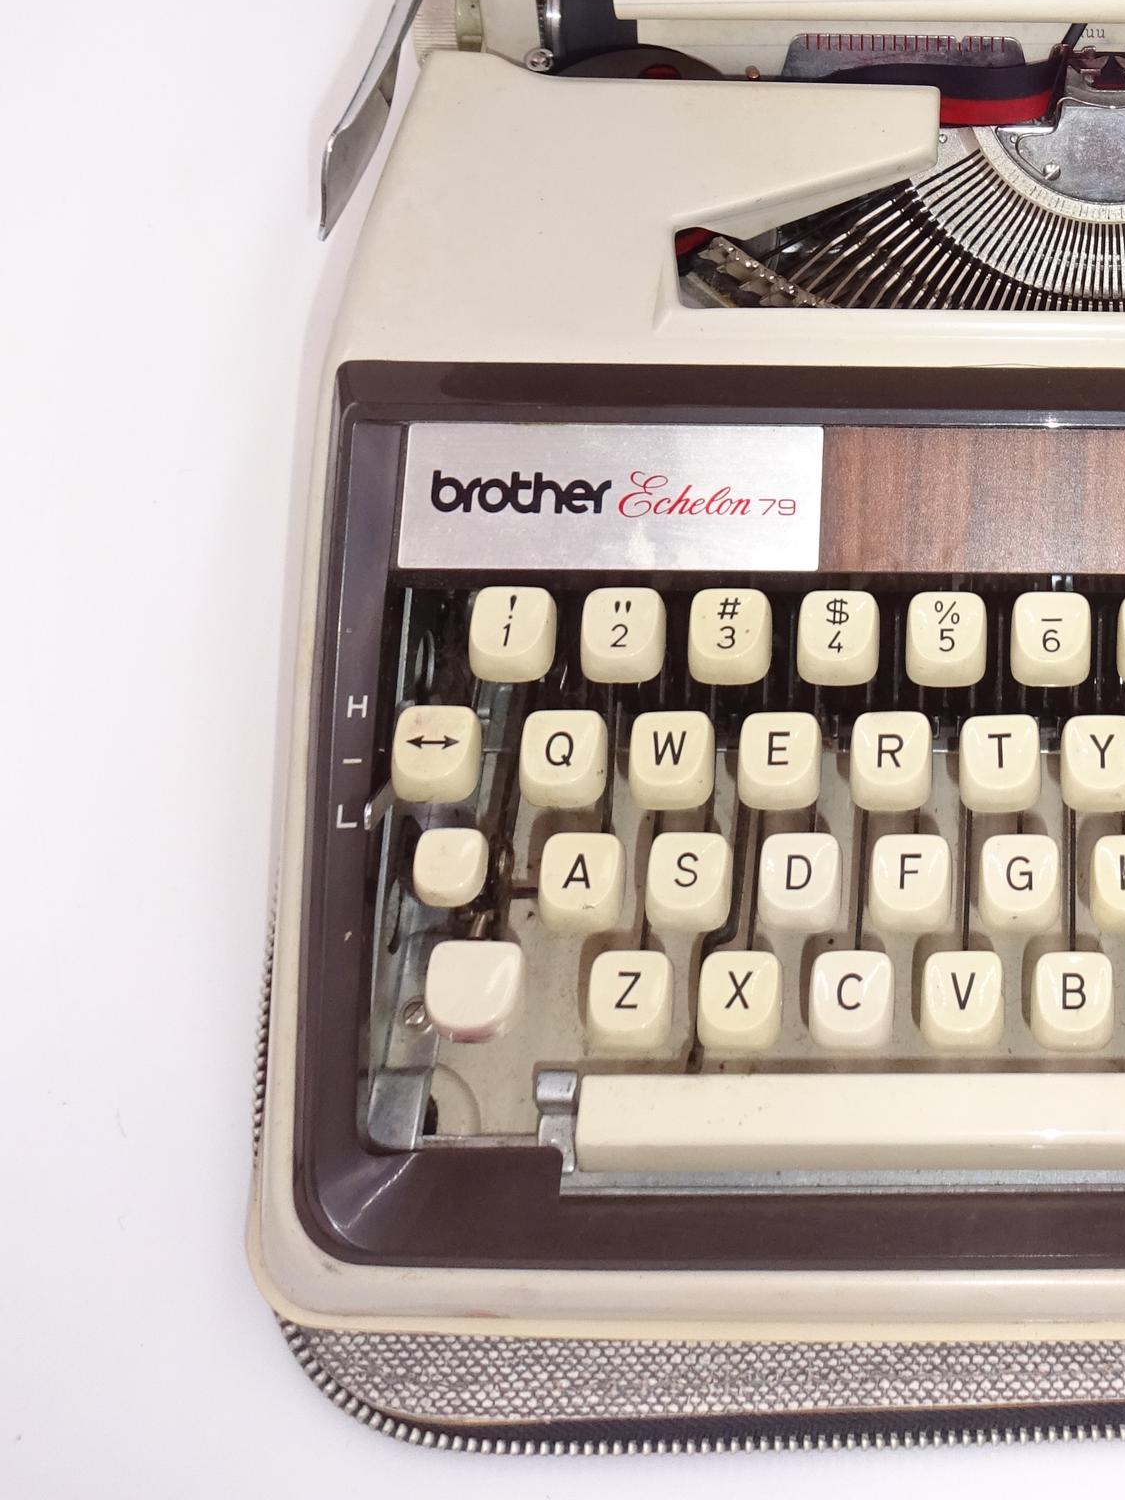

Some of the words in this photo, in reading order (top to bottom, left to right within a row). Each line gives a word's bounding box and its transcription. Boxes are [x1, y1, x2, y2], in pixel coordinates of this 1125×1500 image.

[1080, 27, 1106, 39] uu
[431, 470, 612, 514] brother
[618, 470, 752, 518] Echelon
[758, 498, 797, 516] 79
[507, 594, 518, 620] !
[614, 600, 632, 614] "
[716, 597, 742, 620] #
[825, 597, 850, 626] $
[934, 600, 961, 625] %
[502, 622, 512, 647] 1
[610, 623, 629, 648] 2
[716, 625, 736, 650] 3
[827, 630, 844, 654] 4
[938, 627, 956, 653] 5
[1042, 628, 1061, 653] 6
[347, 695, 368, 718] H
[544, 731, 574, 768] Q
[652, 730, 687, 767] W
[767, 731, 791, 766] E
[876, 733, 904, 769] R
[987, 732, 1012, 769] T
[1089, 733, 1115, 770] Y
[336, 804, 358, 829] L
[561, 853, 591, 890] A
[673, 851, 699, 888] S
[785, 854, 813, 891] D
[899, 853, 923, 890] F
[1005, 855, 1033, 892] G
[614, 971, 642, 1010] Z
[724, 970, 754, 1010] X
[836, 972, 863, 1011] C
[950, 971, 976, 1011] V
[1061, 972, 1087, 1011] B
